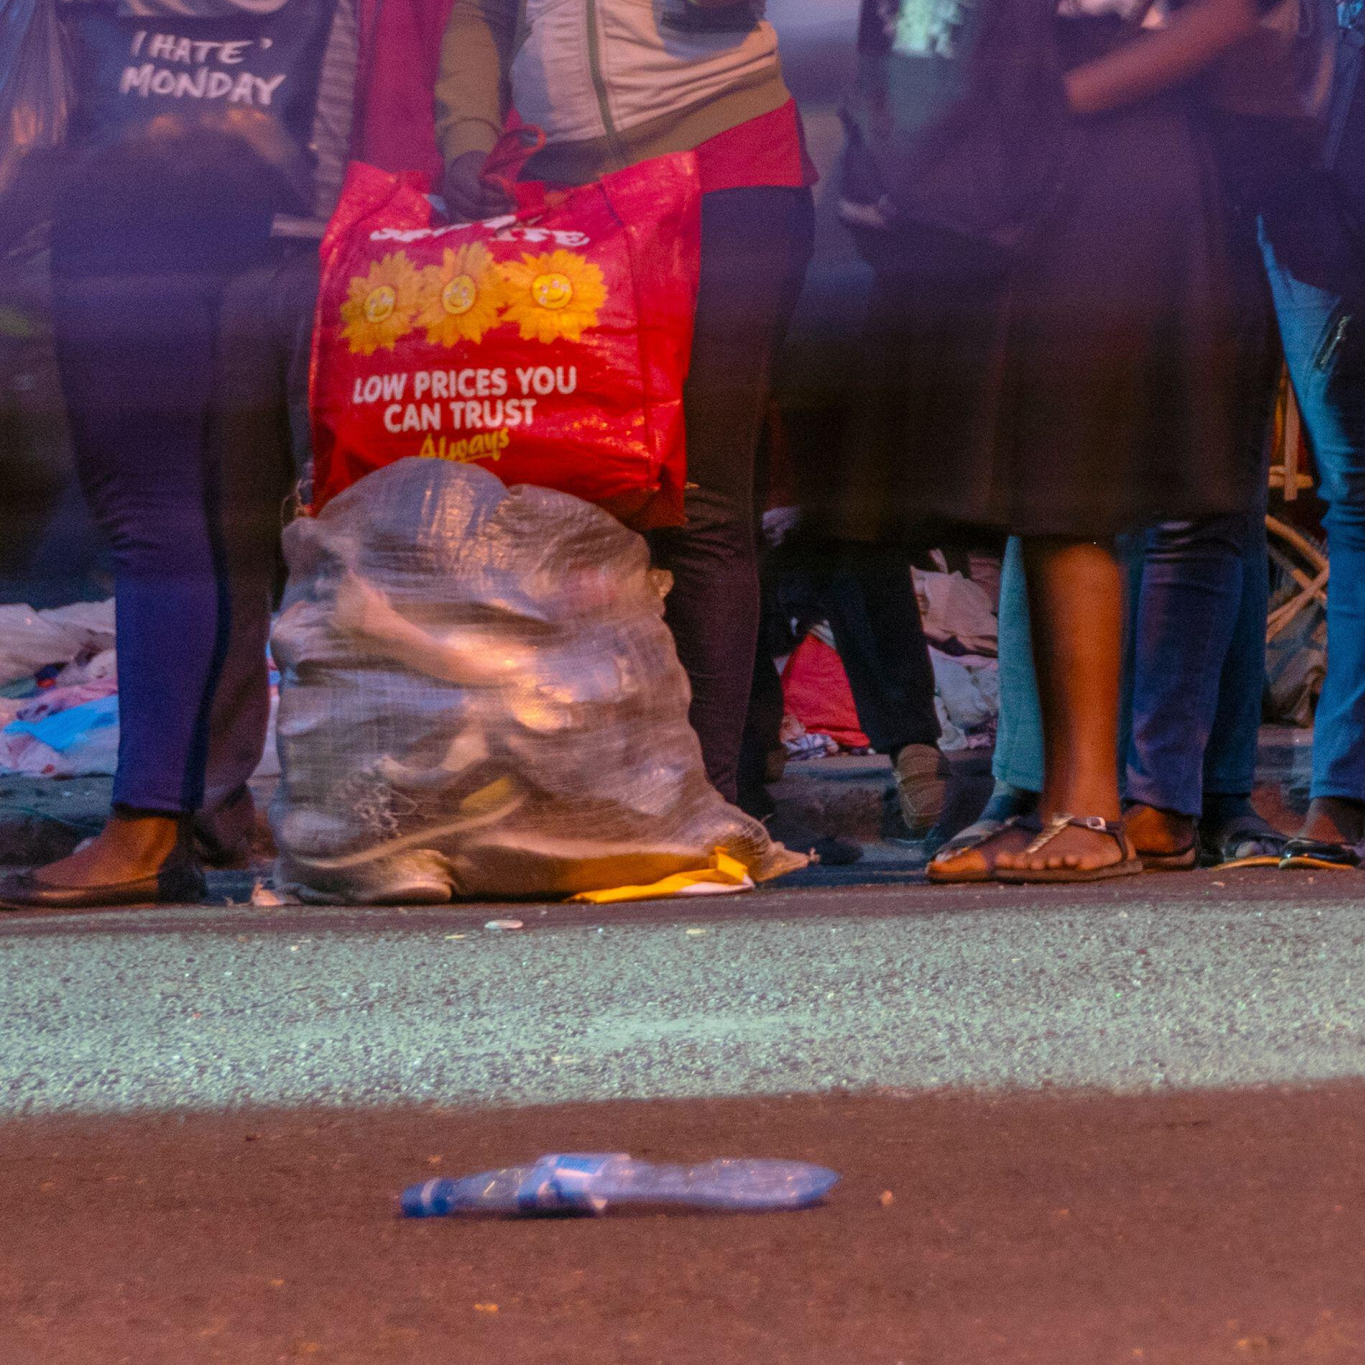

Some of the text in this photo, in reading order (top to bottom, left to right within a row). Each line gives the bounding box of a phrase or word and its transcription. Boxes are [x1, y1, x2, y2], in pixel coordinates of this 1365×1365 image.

[130, 29, 254, 65] I HATE
[118, 63, 287, 107] MONDAY
[352, 365, 578, 405] LOW PRICES YOU
[383, 397, 538, 434] CAN TRUST
[418, 427, 511, 463] Always
